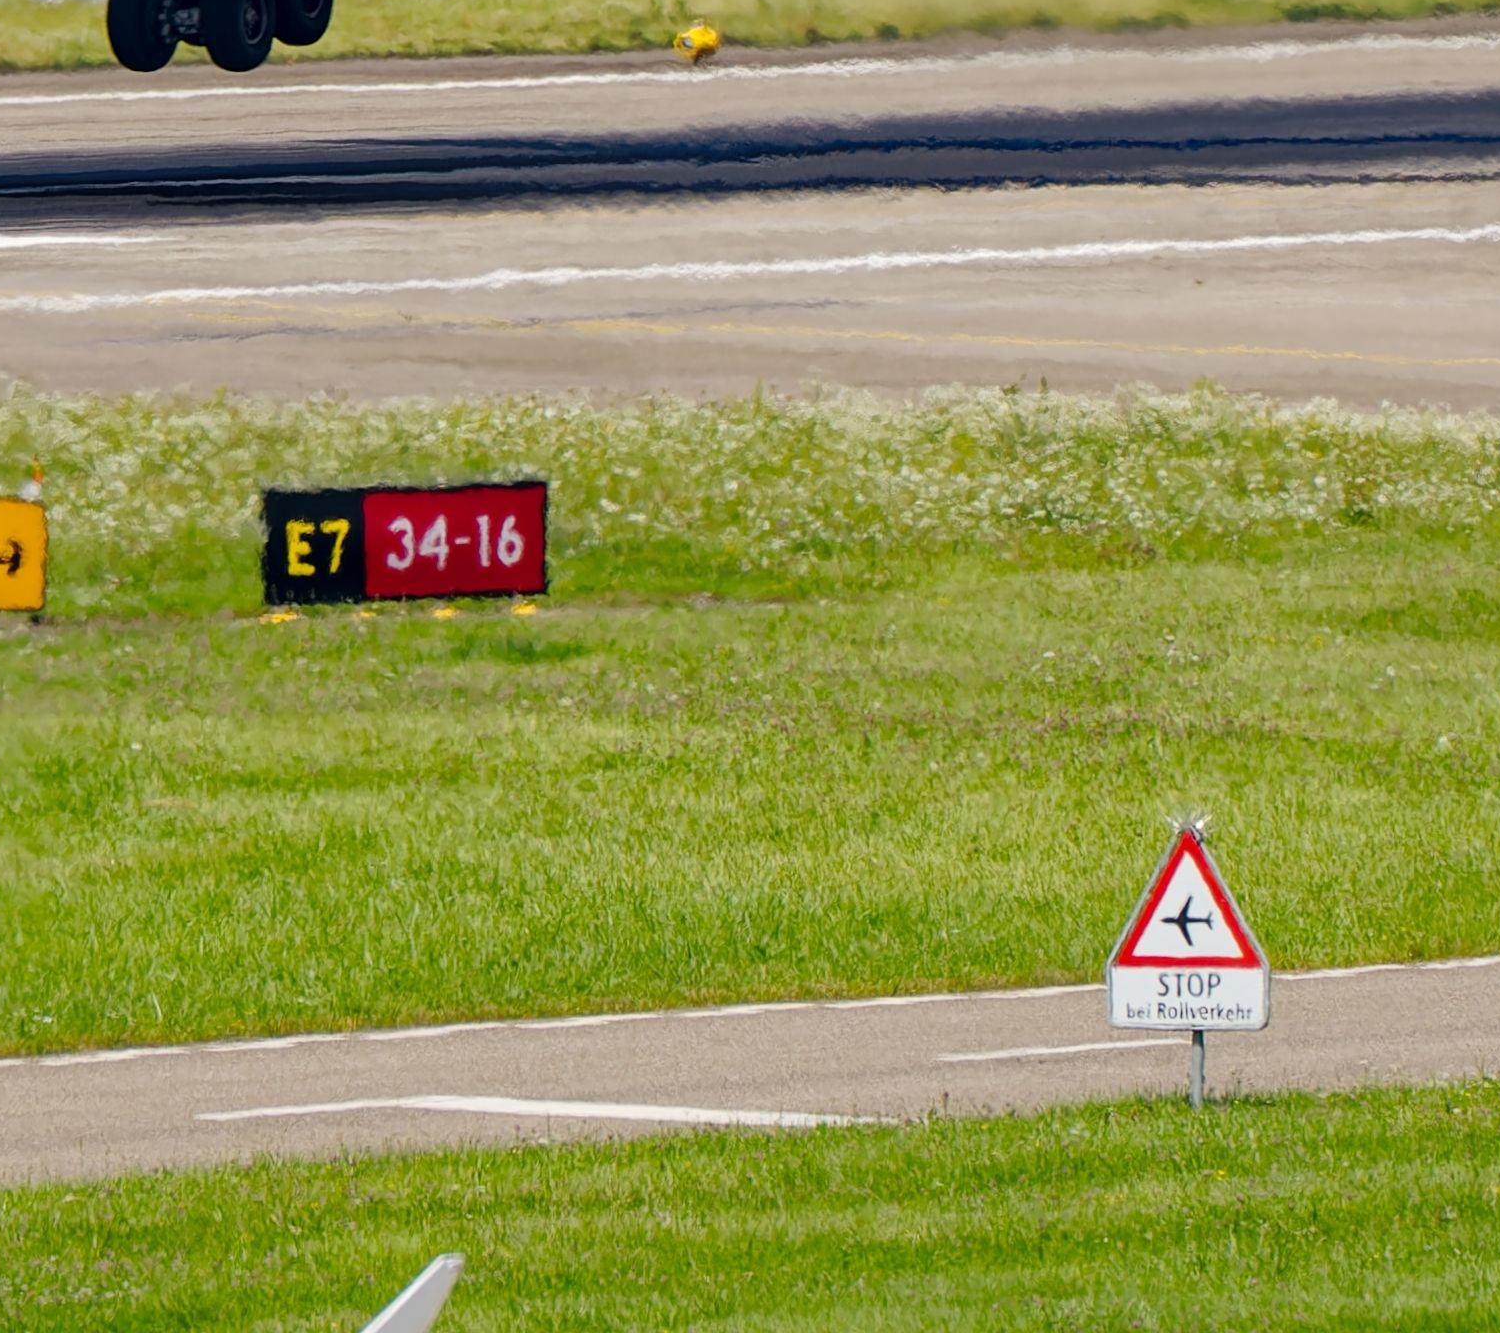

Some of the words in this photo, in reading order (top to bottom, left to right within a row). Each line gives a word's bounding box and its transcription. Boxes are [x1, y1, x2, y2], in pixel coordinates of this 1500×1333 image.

[285, 518, 350, 576] E7
[386, 514, 525, 571] 34-16
[1157, 973, 1221, 998] STOP
[1126, 1003, 1150, 1020] bei
[1157, 1002, 1253, 1022] Rollverkehr
